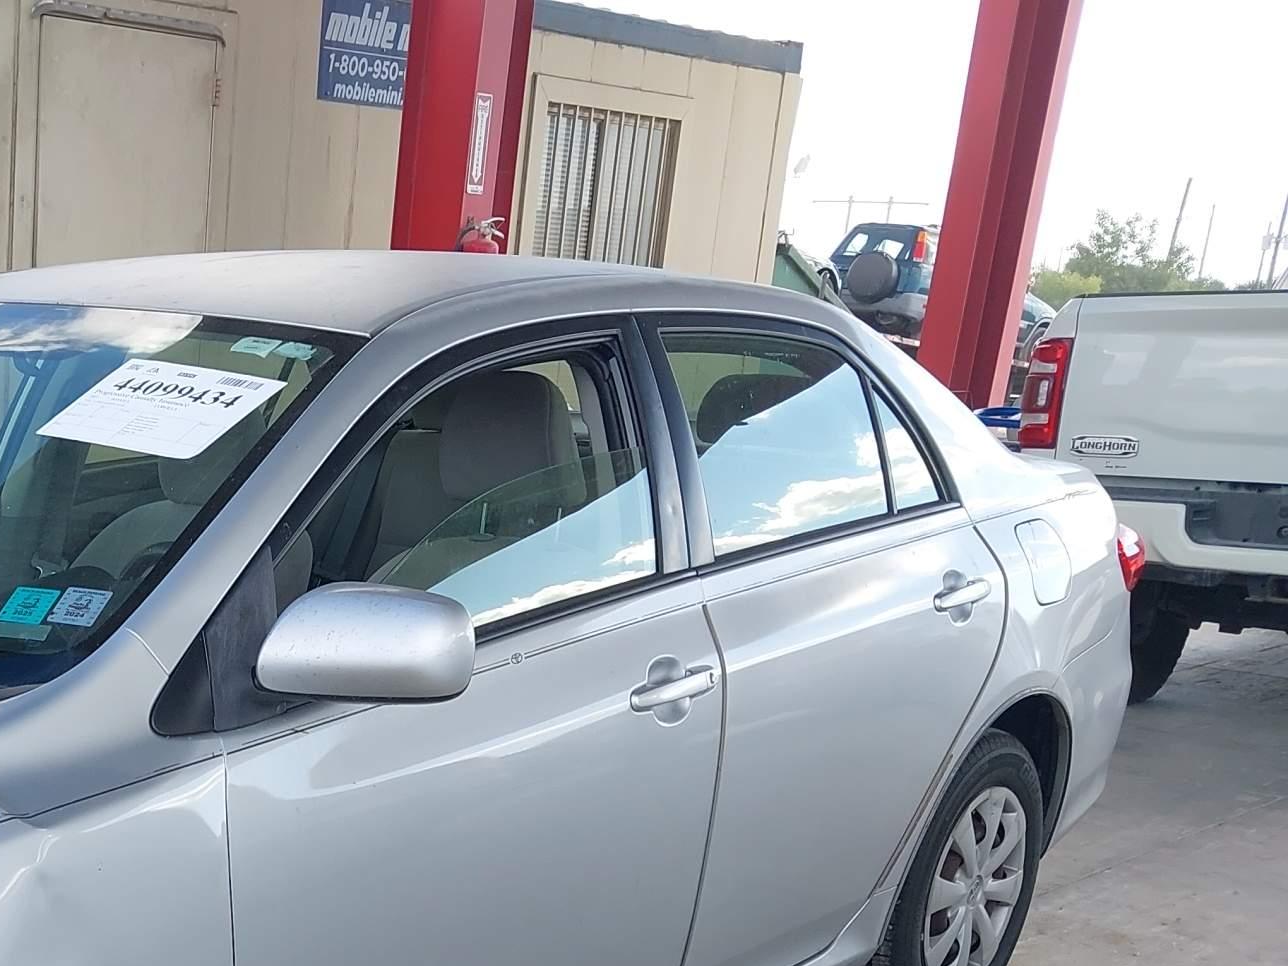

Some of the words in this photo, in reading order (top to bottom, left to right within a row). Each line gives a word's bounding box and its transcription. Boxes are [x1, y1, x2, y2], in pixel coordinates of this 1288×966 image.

[325, 3, 398, 50] mobile
[329, 53, 407, 82] 1-800-950-
[333, 81, 404, 106] mobilemini.
[113, 377, 244, 409] 44099434
[1072, 439, 1137, 451] LONGHORN
[64, 610, 85, 618] 2024
